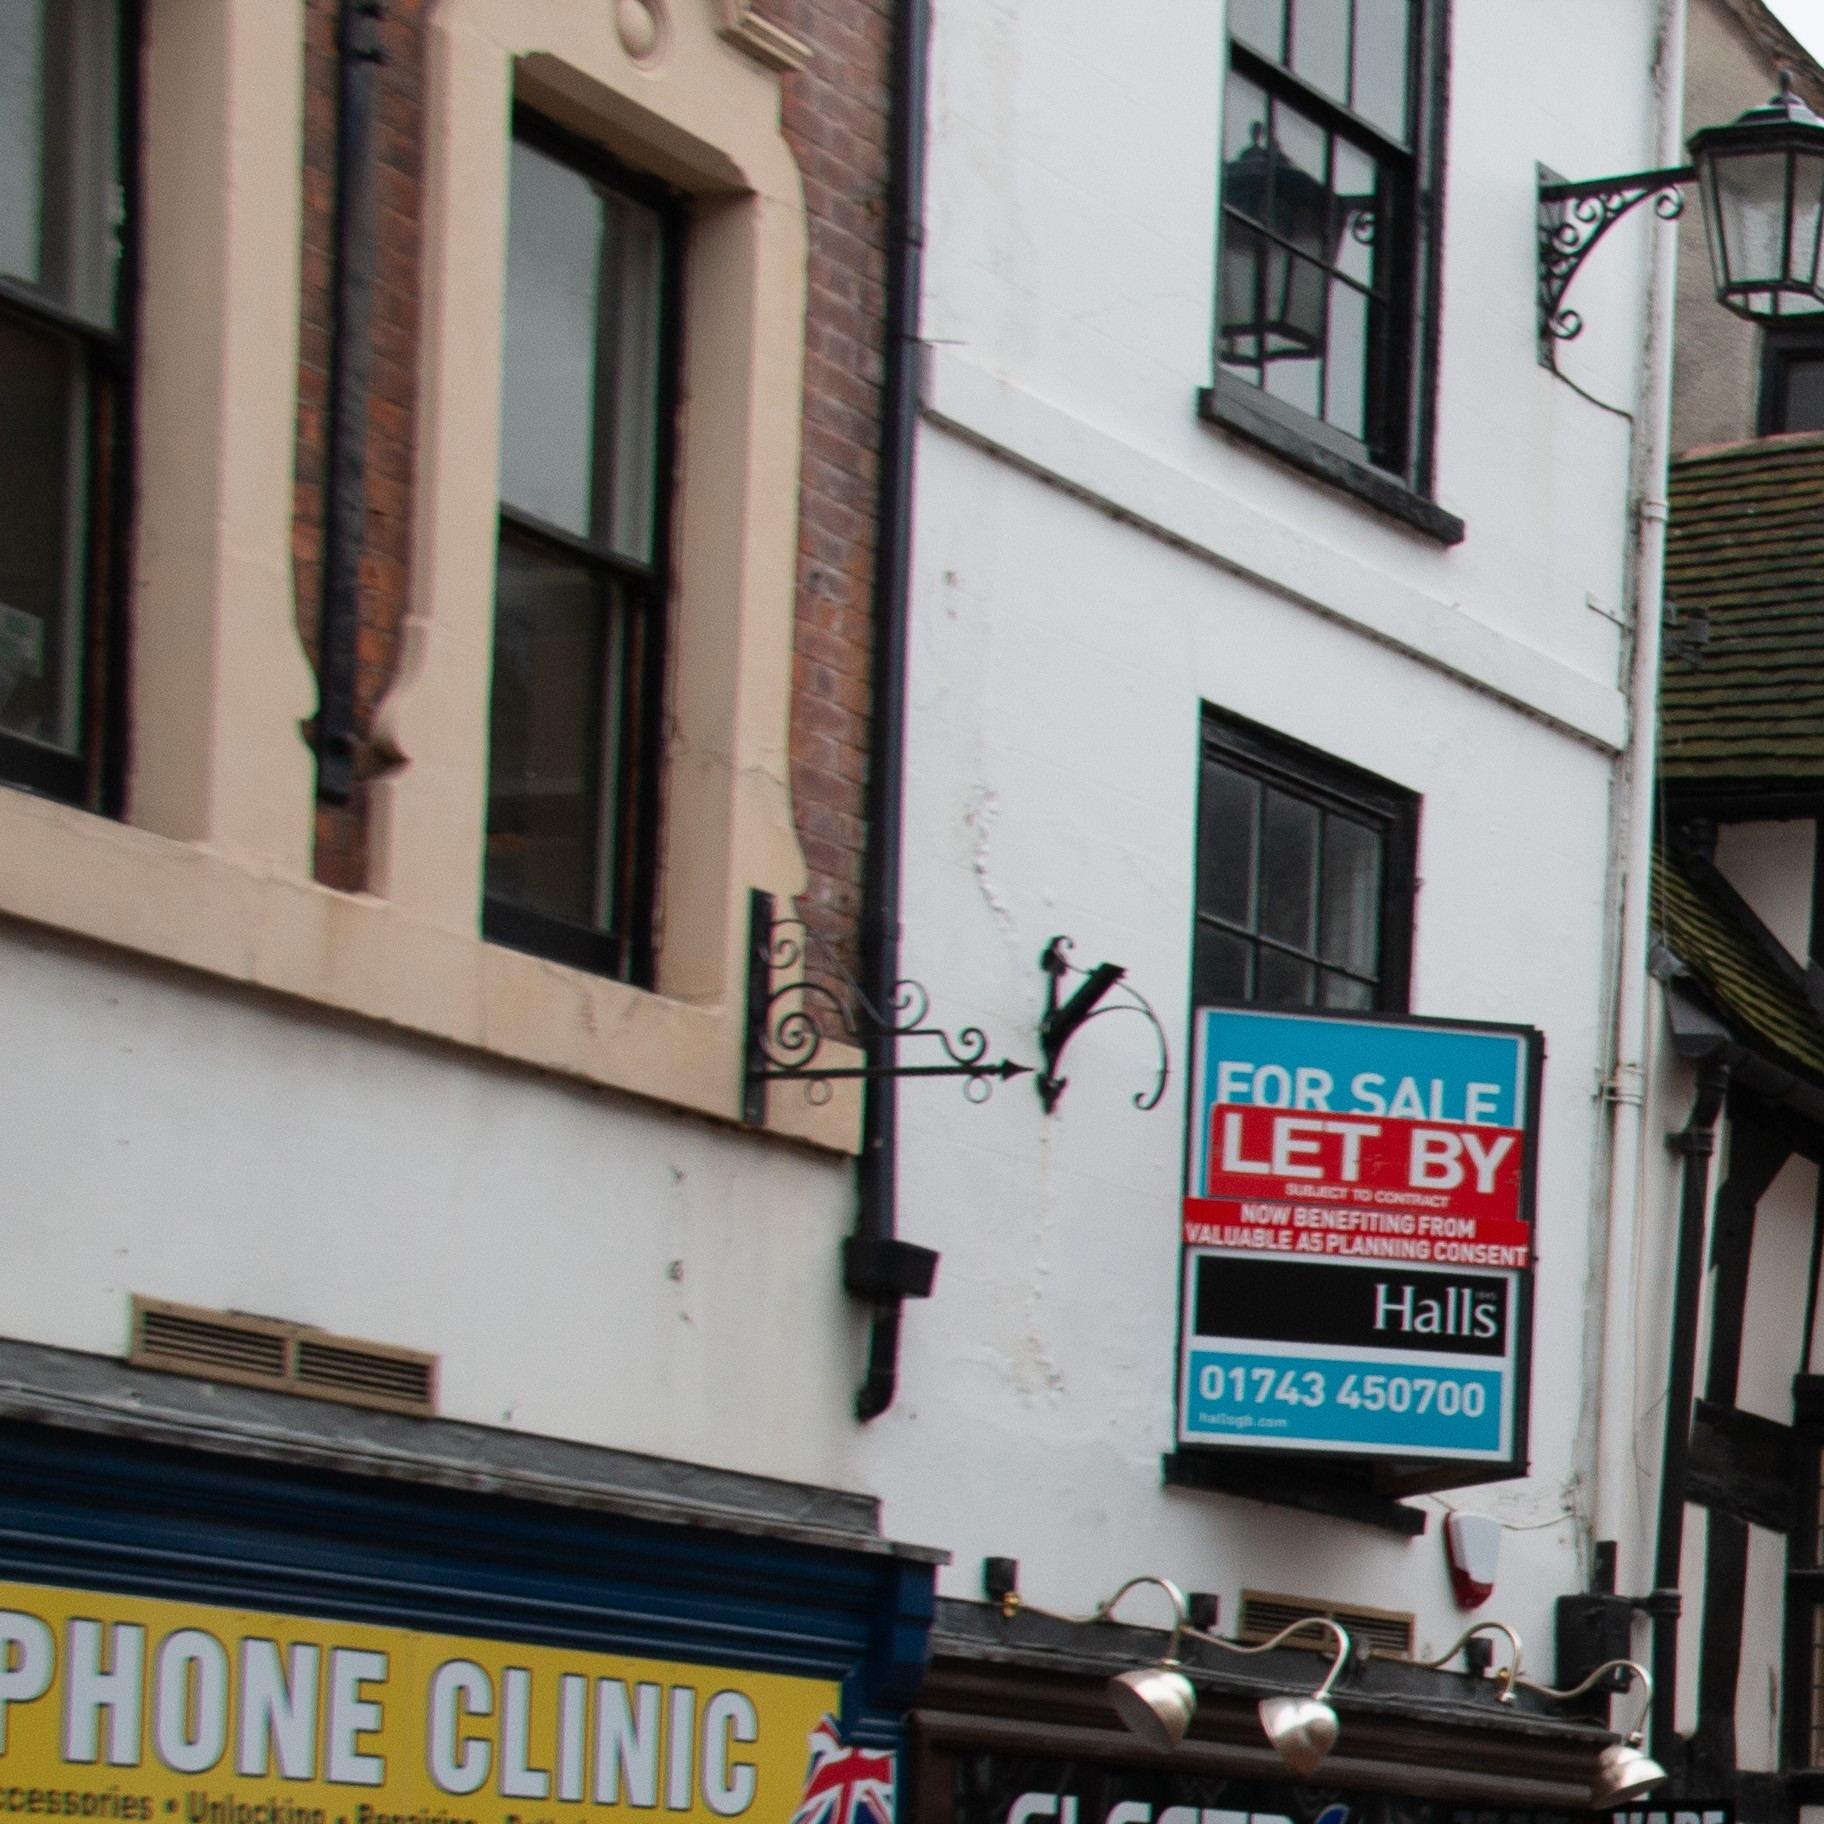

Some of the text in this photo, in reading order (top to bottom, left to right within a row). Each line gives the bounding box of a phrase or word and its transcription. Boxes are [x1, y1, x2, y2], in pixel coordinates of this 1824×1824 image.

[1216, 1060, 1501, 1127] FOR SALE
[1221, 1112, 1516, 1194] LET BY
[1185, 1222, 1293, 1250] VALUABLE
[1326, 1233, 1433, 1261] PLANNING
[1434, 1241, 1529, 1268] CONSENT
[1240, 1203, 1477, 1239] NOW BENEFITING FROM
[1373, 1281, 1499, 1339] Halls
[1199, 1363, 1486, 1419] 01743 450700
[0, 1611, 760, 1818] PHONE CLINIC
[0, 1784, 154, 1821] cessories
